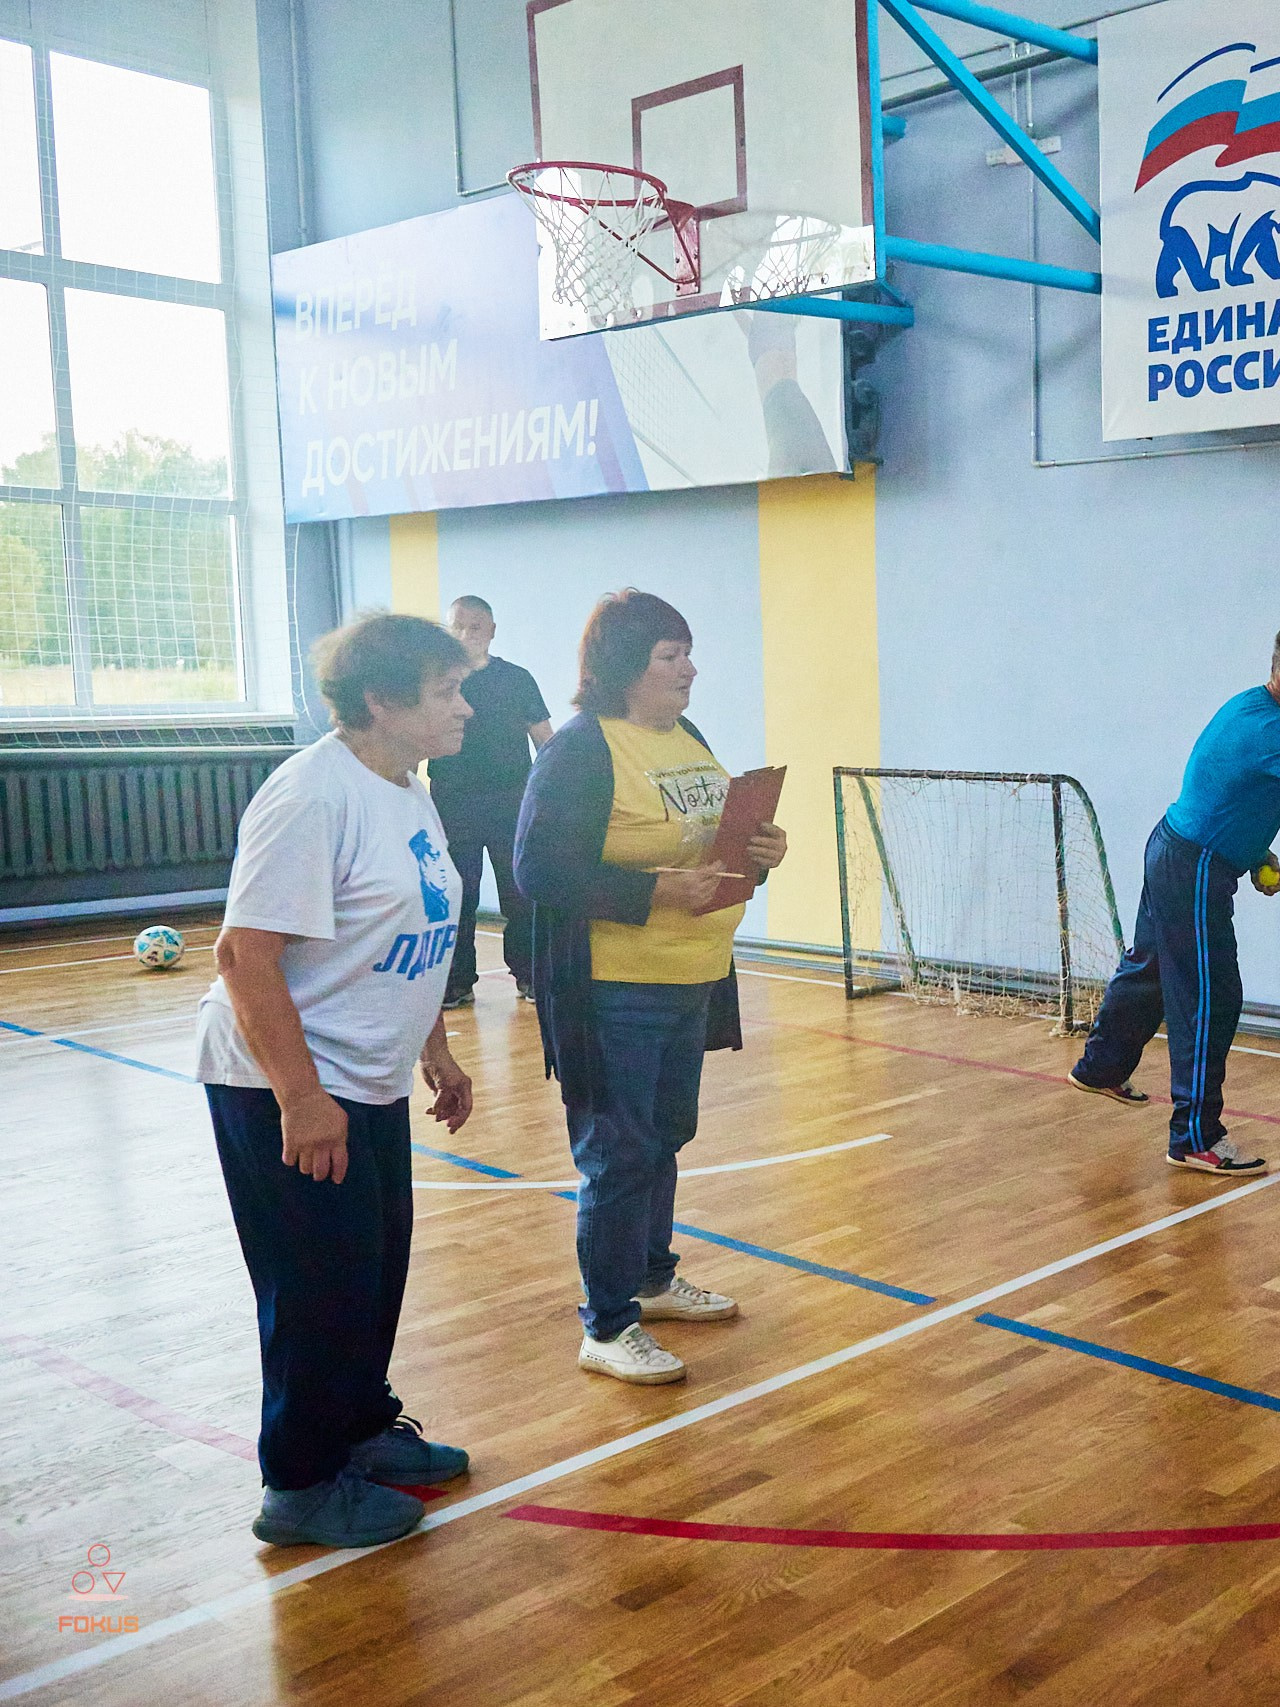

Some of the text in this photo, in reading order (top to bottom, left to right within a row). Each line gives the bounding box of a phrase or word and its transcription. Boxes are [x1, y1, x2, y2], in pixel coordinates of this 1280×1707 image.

[295, 270, 418, 341] ВПЕРЕД
[299, 338, 458, 416] К НОВЫМ
[301, 398, 600, 498] ДОСТИЖЕНИЯМ!
